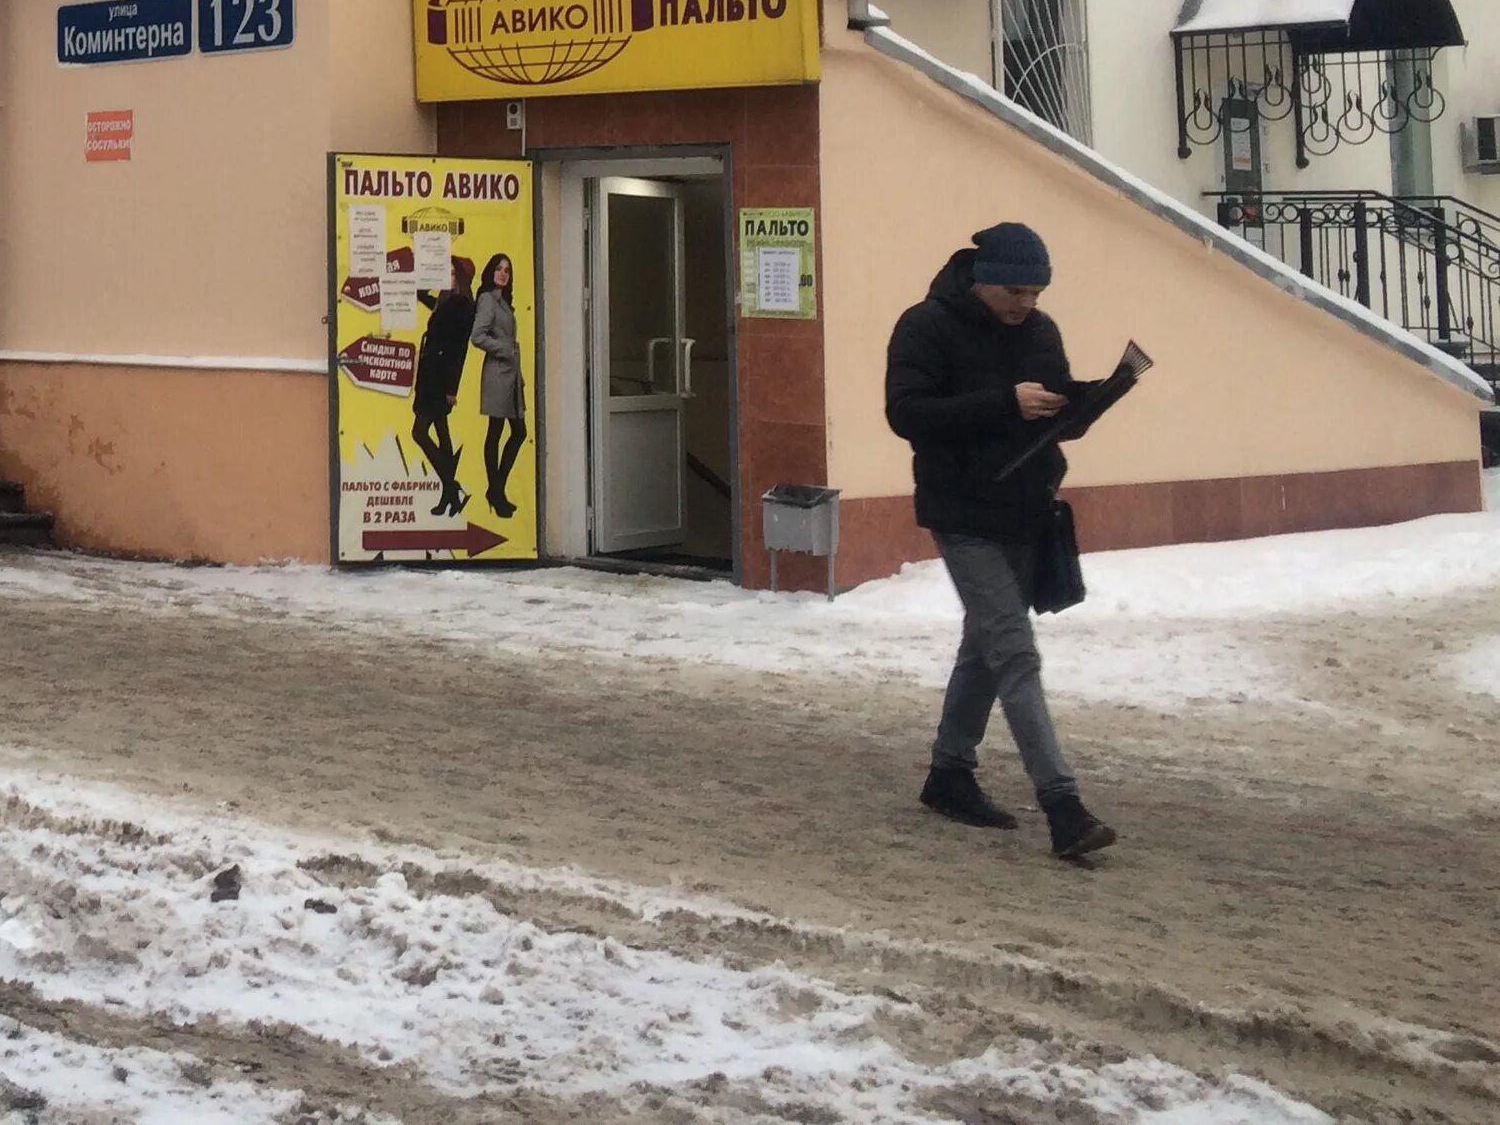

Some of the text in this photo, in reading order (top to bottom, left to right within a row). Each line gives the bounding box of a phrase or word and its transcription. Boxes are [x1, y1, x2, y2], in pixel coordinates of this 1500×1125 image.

[108, 2, 138, 22] улица
[490, 4, 589, 36] АВИКО
[64, 21, 184, 57] Коминтерна
[344, 169, 519, 201] ПАЛЬТО АВИКО
[418, 223, 448, 233] АВИКО
[745, 219, 809, 236] ПАЛЬТО
[361, 340, 411, 358] Скидки по
[369, 369, 398, 381] карте
[342, 481, 440, 491] ПАЛЬТО С ФАБРИКИ
[366, 495, 414, 507] ДЕШЕВЛЕ
[363, 512, 416, 523] В 2 РАЗА
